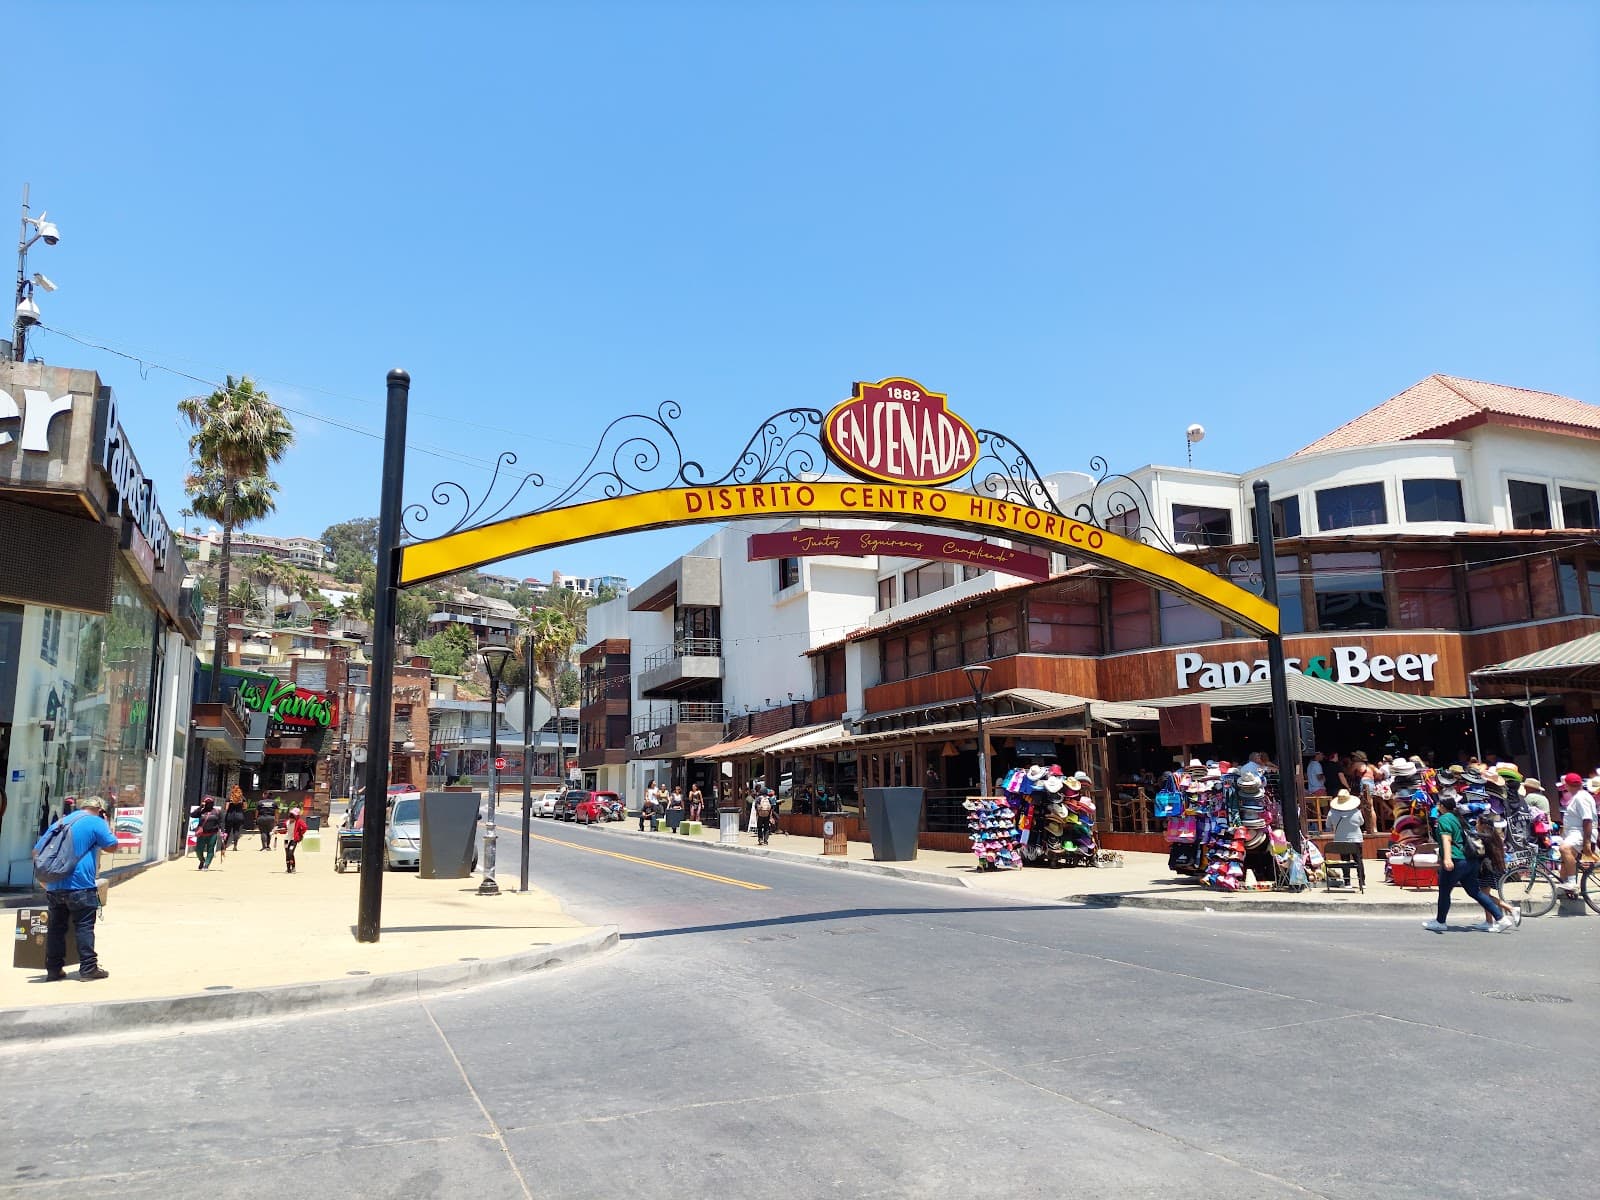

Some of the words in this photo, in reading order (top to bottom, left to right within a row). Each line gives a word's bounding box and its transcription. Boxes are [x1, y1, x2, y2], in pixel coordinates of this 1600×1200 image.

[887, 387, 920, 402] 1882
[836, 402, 970, 477] ENSENADA
[685, 485, 815, 514] DISTRITO
[840, 488, 947, 512] CENTRO
[970, 499, 1103, 549] HISTORICO
[860, 533, 924, 551] Seguiremos
[1303, 655, 1332, 681] &
[1333, 646, 1438, 684] Beer
[1554, 716, 1594, 725] ENTRADA
